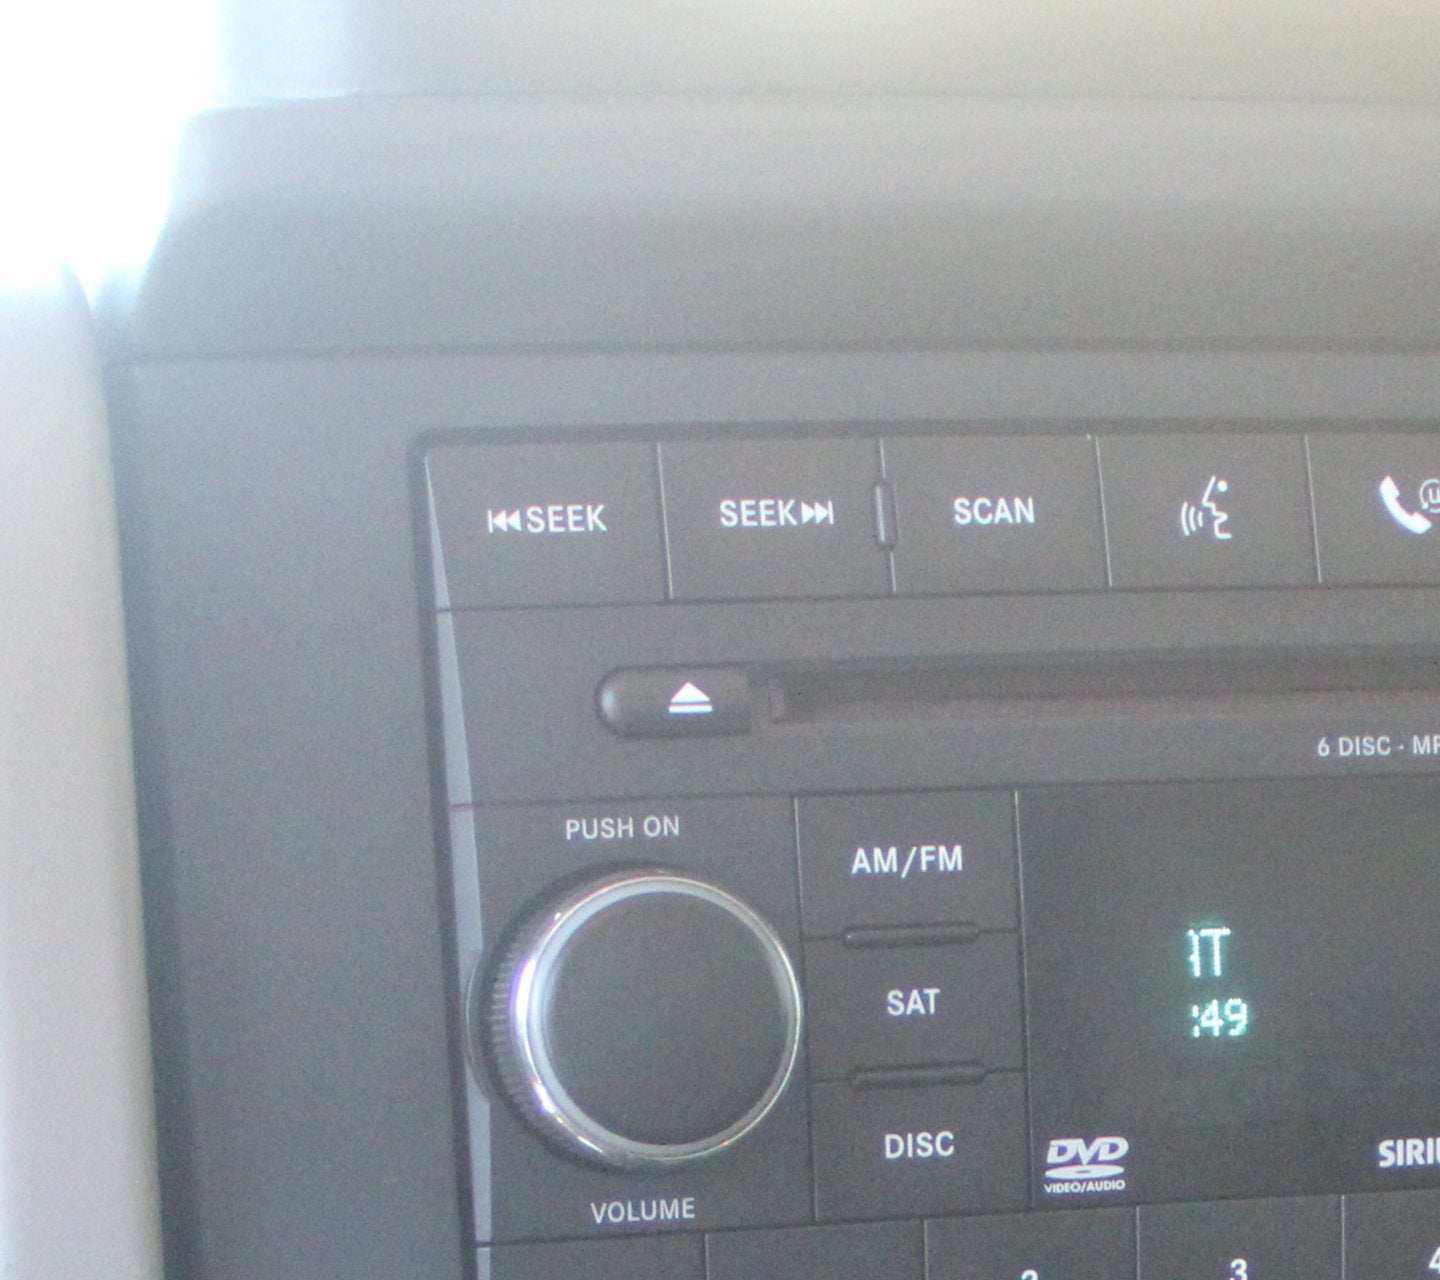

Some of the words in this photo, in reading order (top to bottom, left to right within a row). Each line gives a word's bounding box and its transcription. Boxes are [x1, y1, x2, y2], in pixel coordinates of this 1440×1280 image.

[525, 504, 607, 534] SEEK
[719, 499, 798, 528] SEEK
[953, 496, 1035, 525] SCAN
[1316, 737, 1331, 758] 6
[1337, 735, 1392, 757] DISC
[565, 817, 634, 841] PUSH
[642, 815, 680, 838] ON
[851, 844, 963, 879] AM/FM
[886, 987, 941, 1017] SAT
[884, 1130, 955, 1160] DISC
[1047, 1136, 1129, 1166] DVD
[1044, 1180, 1126, 1194] VIDEO/AUDIO
[590, 1197, 696, 1225] VOLUME
